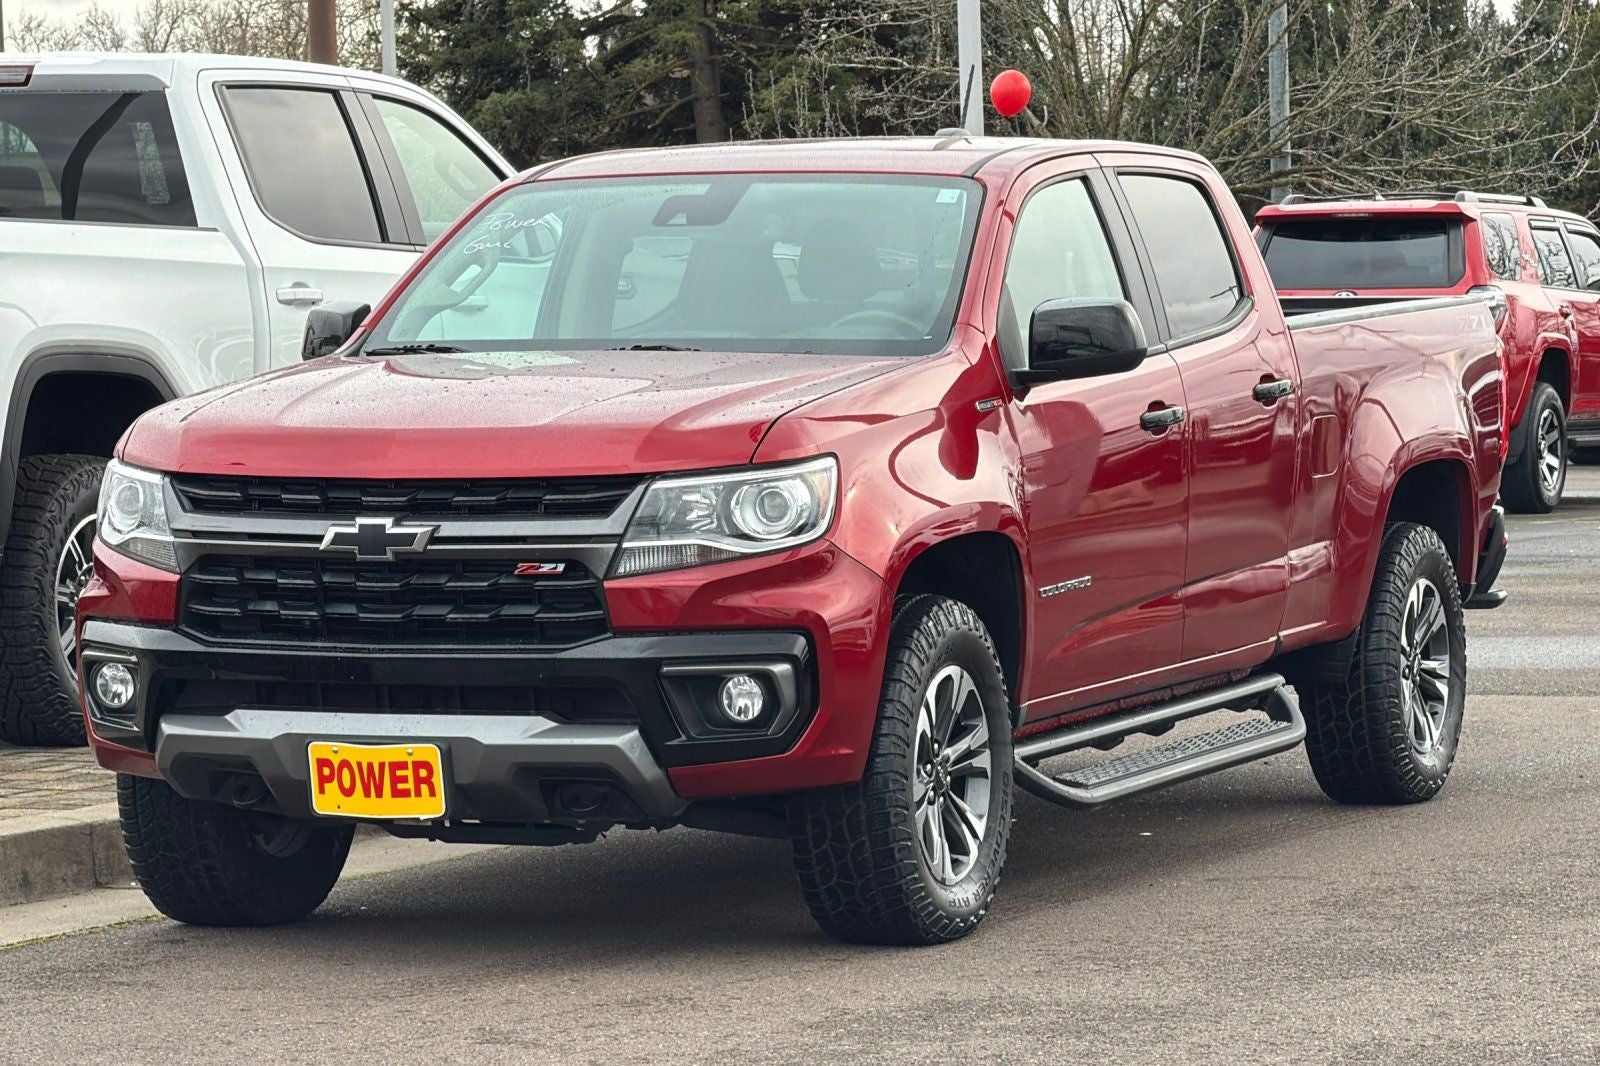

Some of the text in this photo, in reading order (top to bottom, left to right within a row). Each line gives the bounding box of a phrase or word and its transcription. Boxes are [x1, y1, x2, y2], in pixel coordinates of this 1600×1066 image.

[514, 562, 566, 575] Z71
[1038, 575, 1092, 598] COLORADO
[316, 758, 437, 798] POWER
